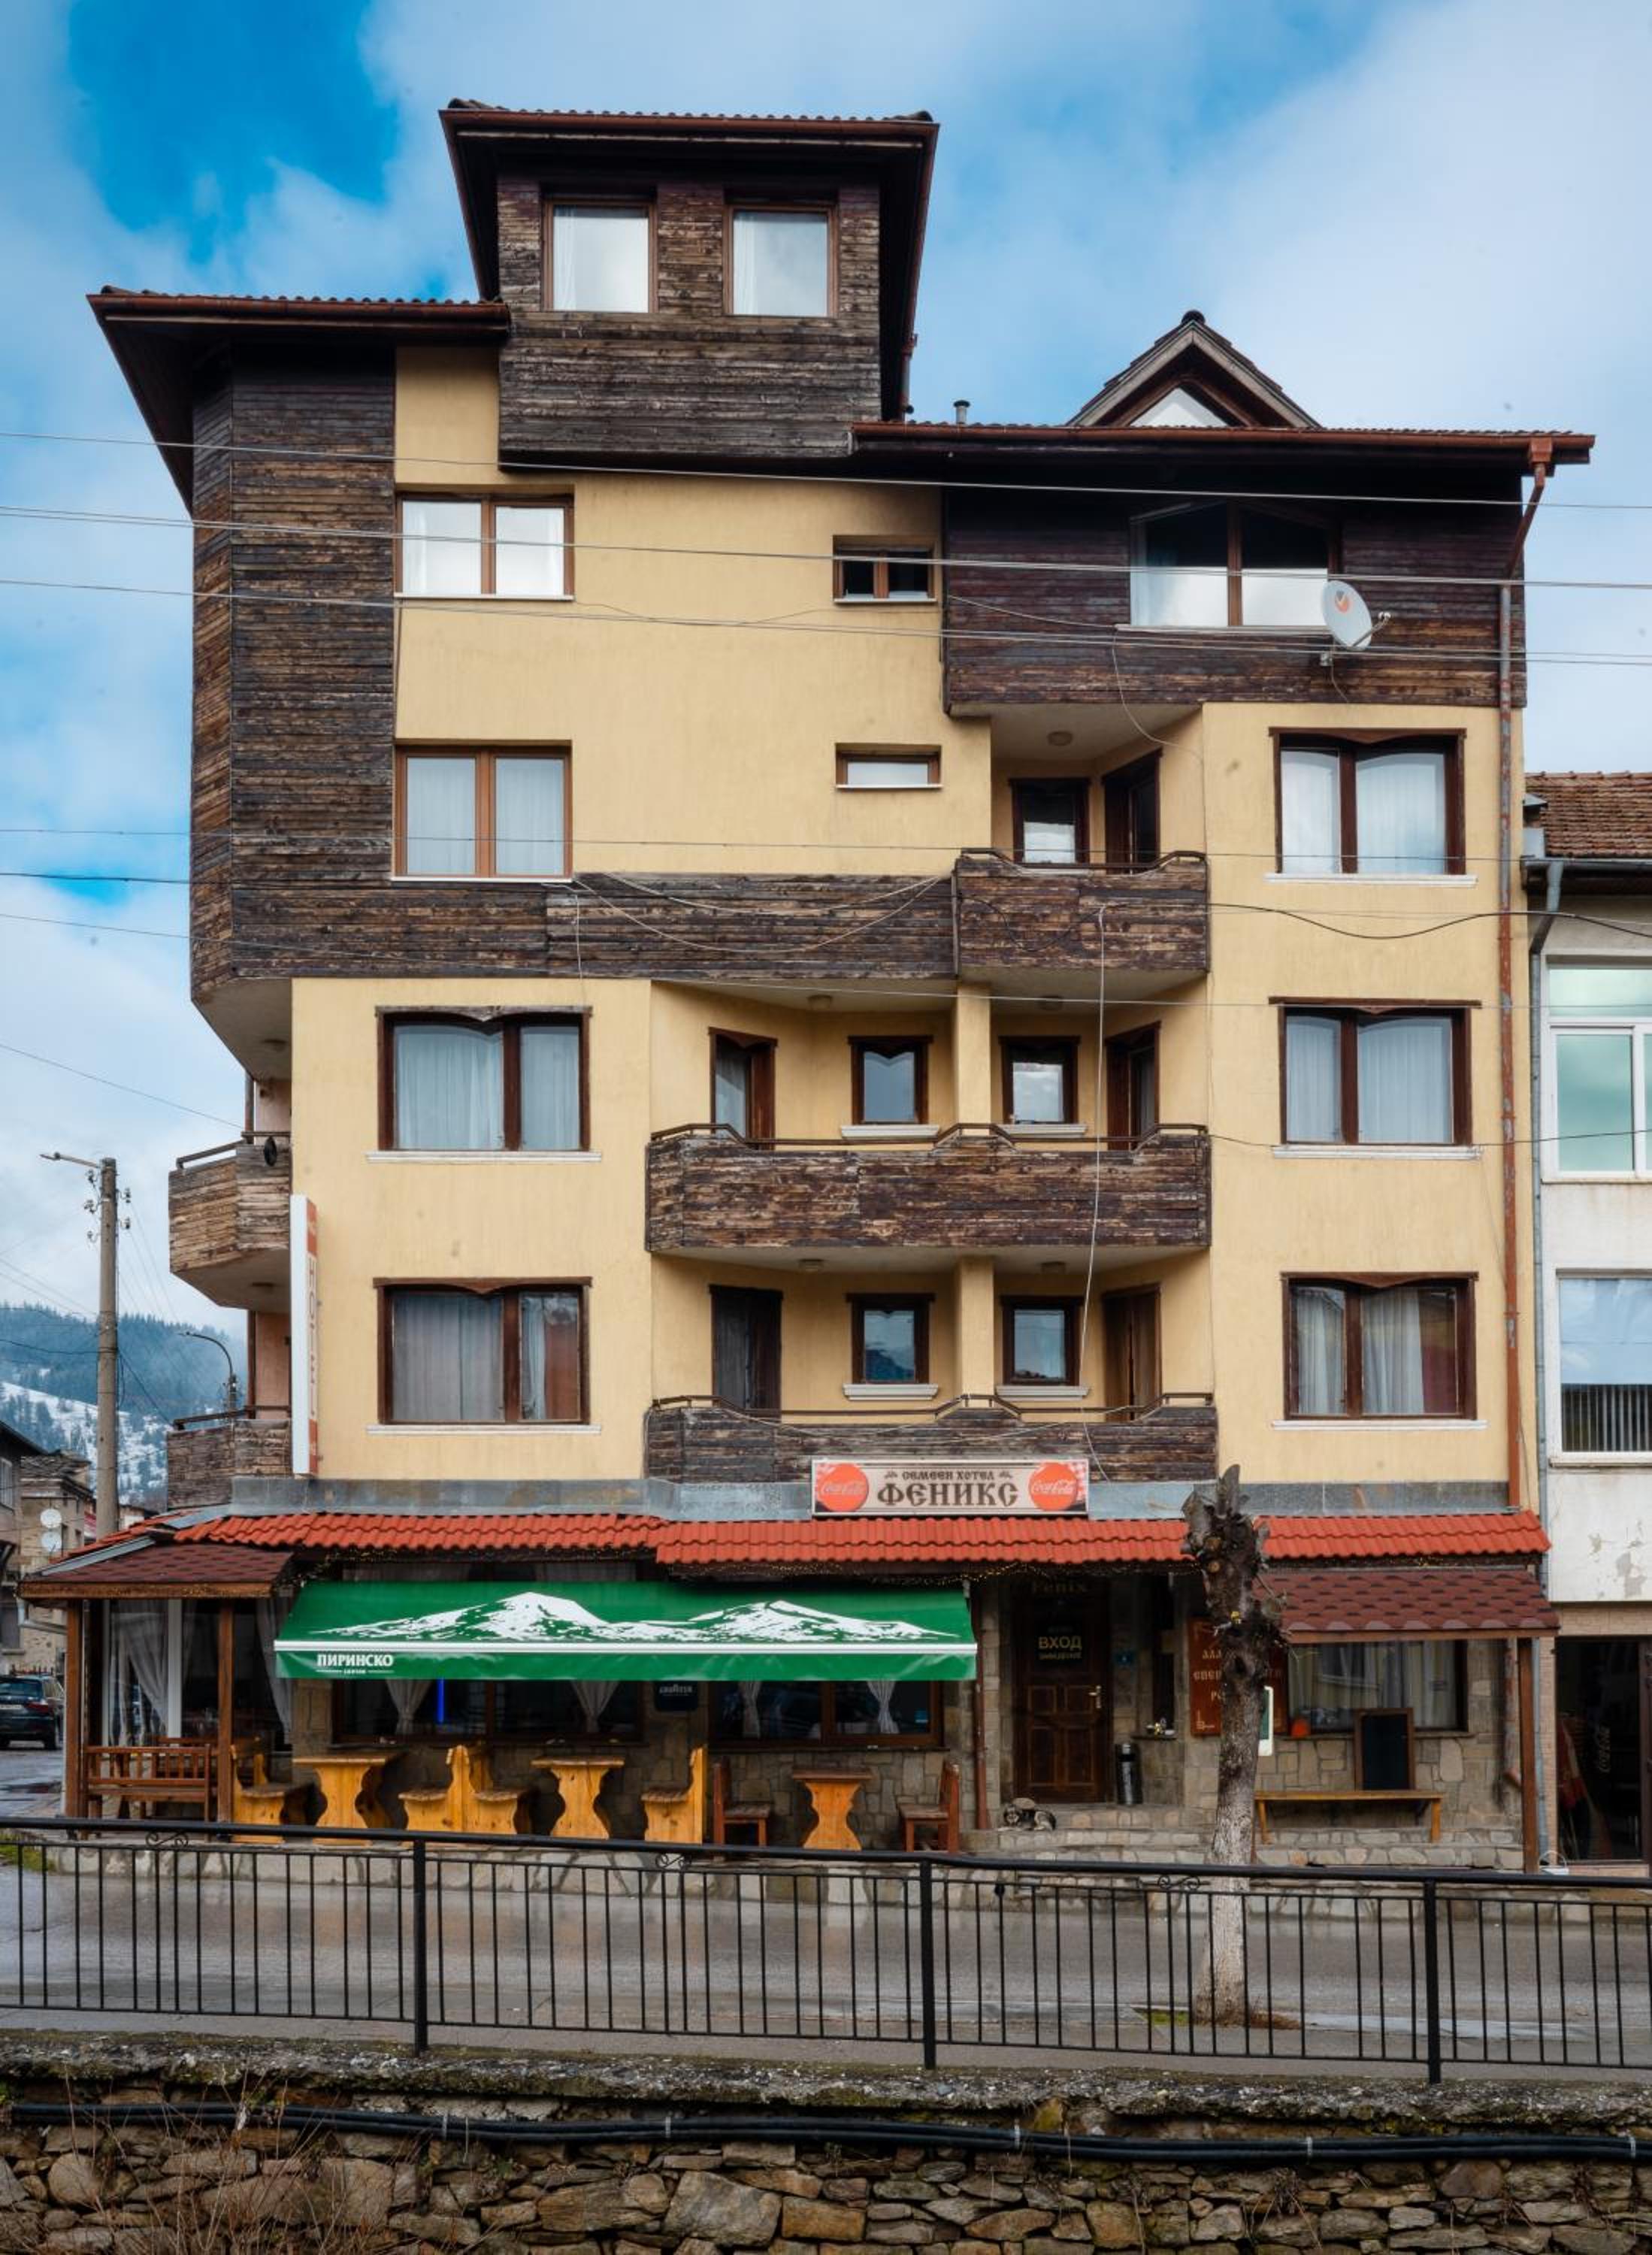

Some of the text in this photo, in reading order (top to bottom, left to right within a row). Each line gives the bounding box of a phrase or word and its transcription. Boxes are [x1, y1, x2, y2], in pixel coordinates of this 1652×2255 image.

[957, 1471, 995, 1480] ХОТЕЛ
[877, 1482, 1018, 1506] ФЕНИКС
[1038, 1636, 1082, 1651] ВХОД
[316, 1654, 394, 1666] ПИРИНСКО
